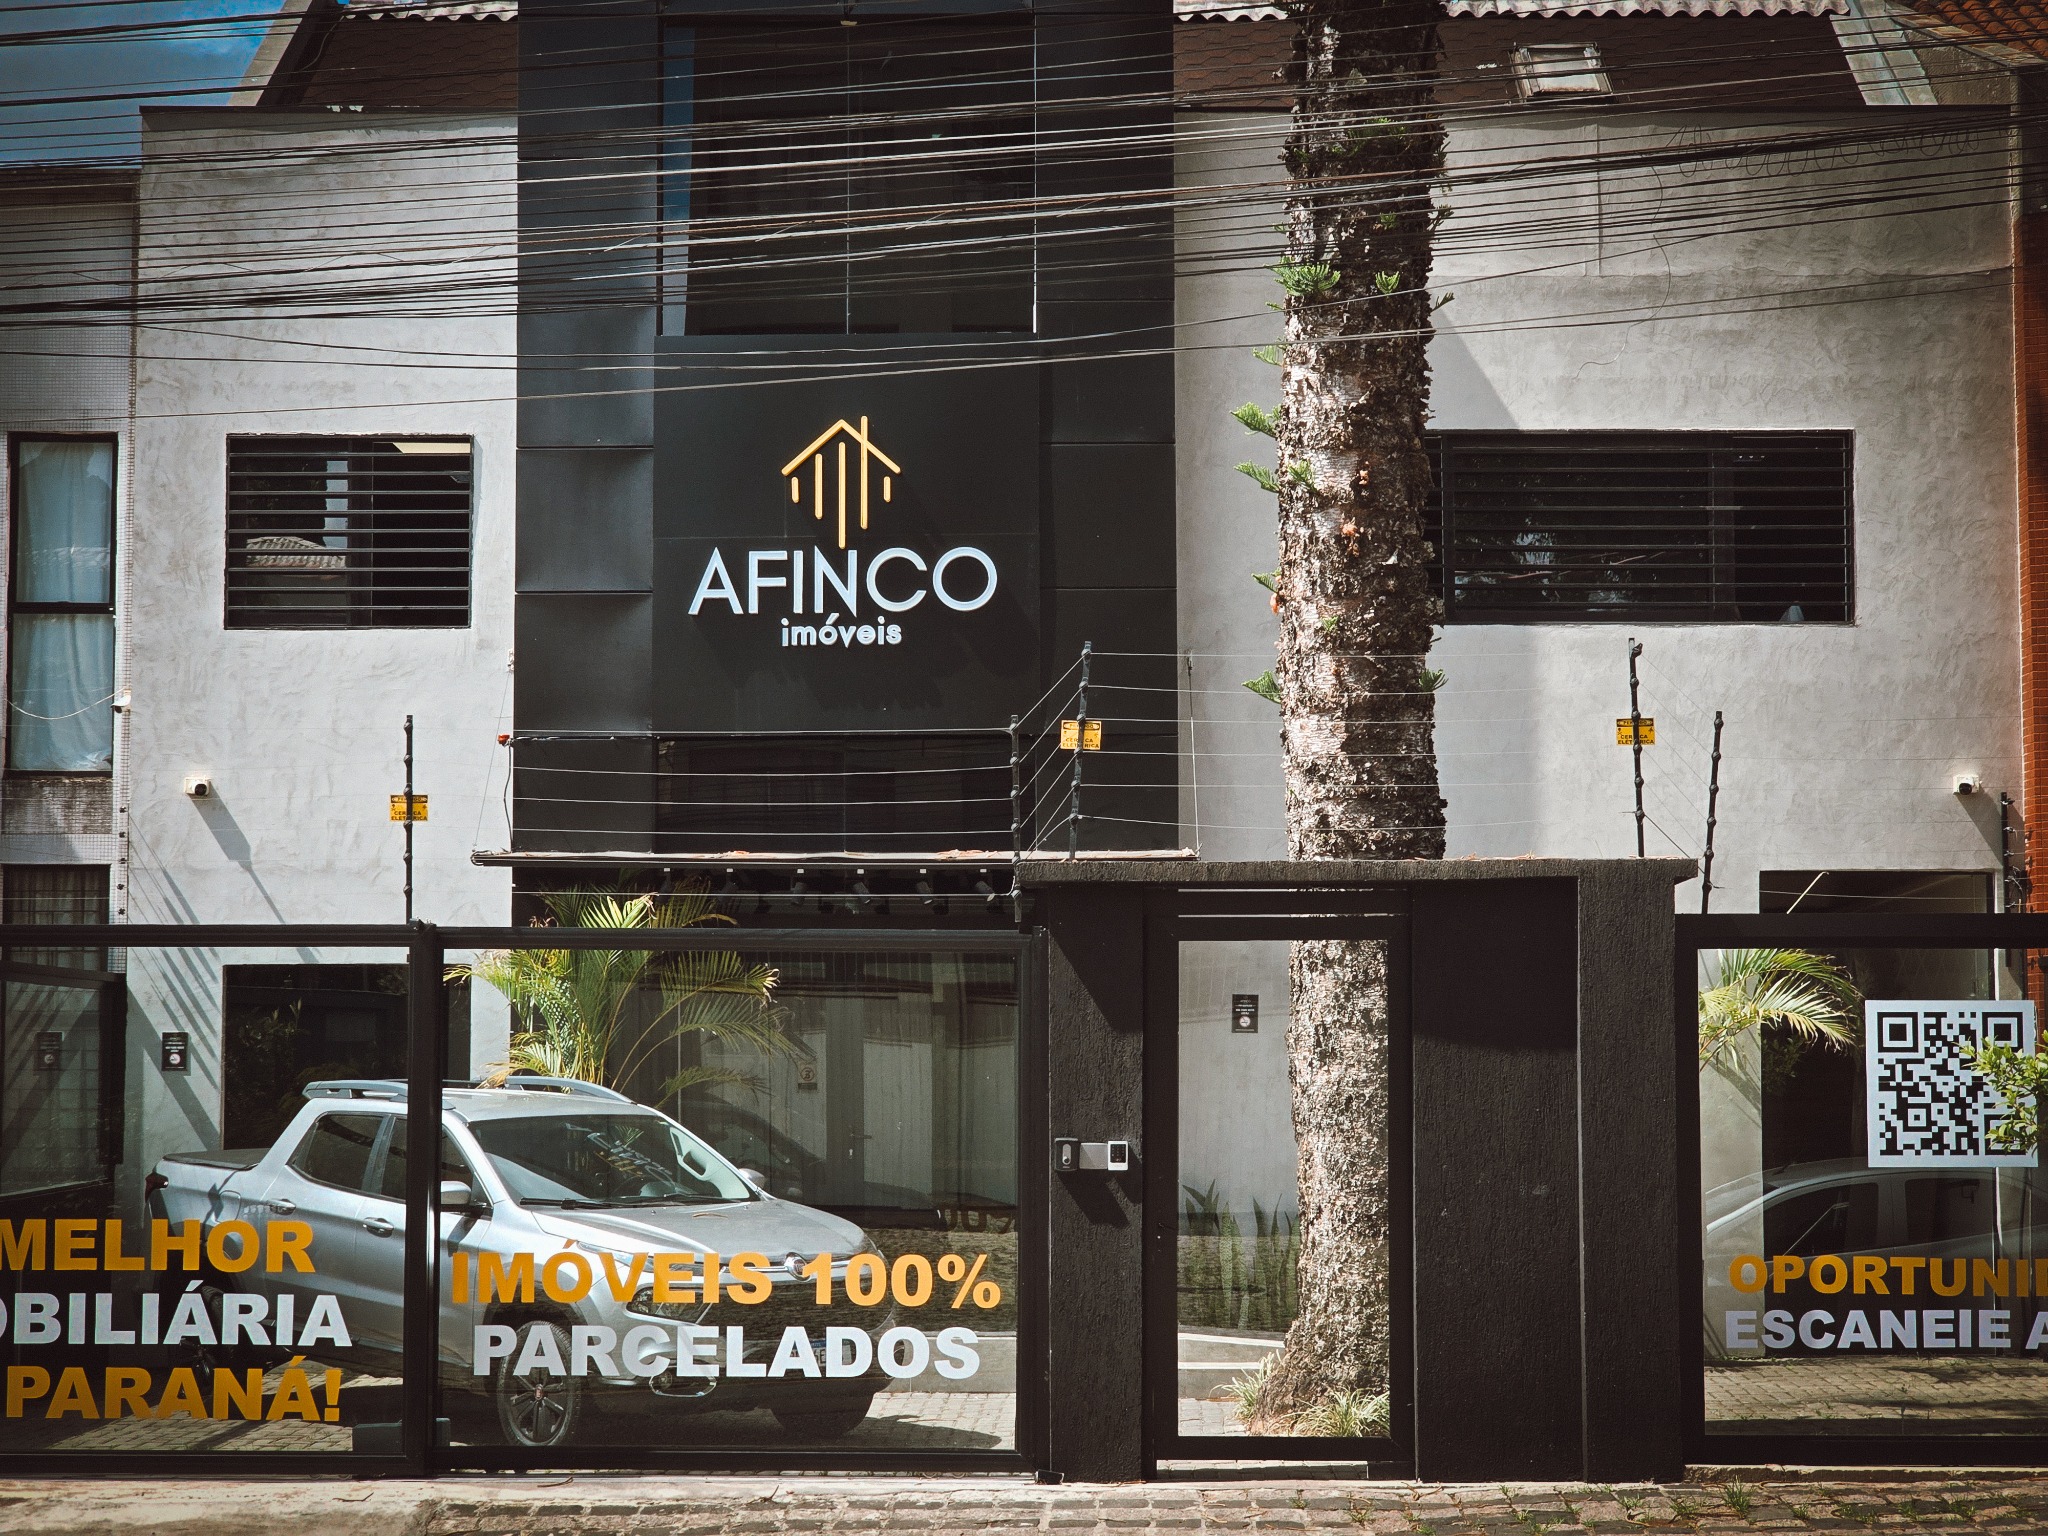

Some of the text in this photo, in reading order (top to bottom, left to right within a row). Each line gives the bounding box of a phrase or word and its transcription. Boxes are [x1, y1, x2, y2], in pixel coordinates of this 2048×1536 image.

[688, 546, 998, 617] AFINCO
[781, 613, 902, 648] imóveis
[0, 1218, 316, 1273] MELHOR
[452, 1240, 1001, 1309] IMÓVEIS 100%
[0, 1280, 352, 1347] BILIÁRIA
[1725, 1309, 2011, 1349] ESCANEIE
[473, 1325, 981, 1379] PARCELADOS
[6, 1355, 342, 1422] PARANÁ!
